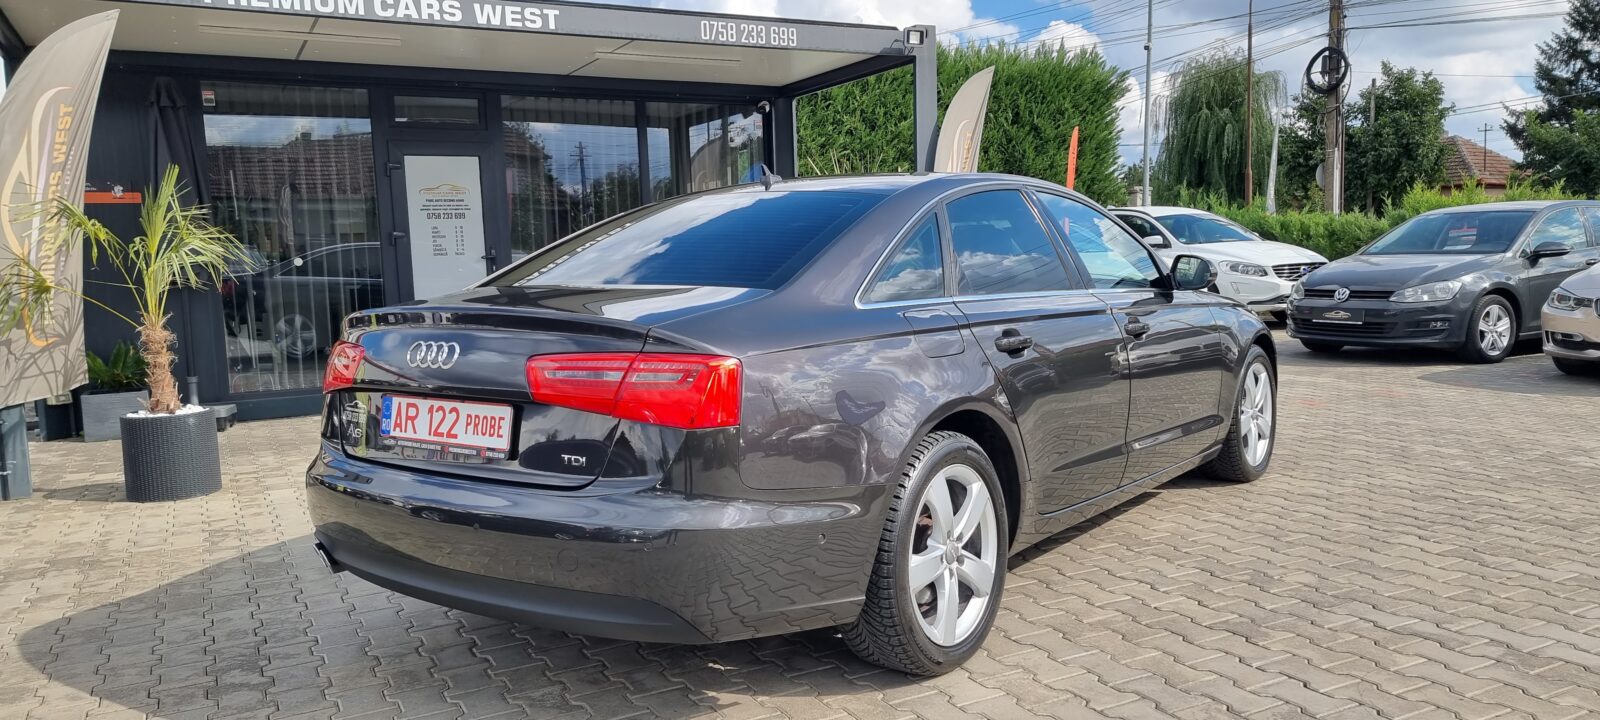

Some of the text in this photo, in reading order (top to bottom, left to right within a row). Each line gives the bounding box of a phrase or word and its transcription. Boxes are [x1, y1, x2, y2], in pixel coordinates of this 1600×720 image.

[203, 0, 560, 30] MIUM CARS WEST
[701, 20, 797, 46] 0758 233 699
[53, 103, 73, 164] WEST
[442, 212, 453, 220] 233
[381, 418, 391, 431] RO
[392, 401, 506, 439] AR 122 PROBE
[561, 454, 587, 468] TDI
